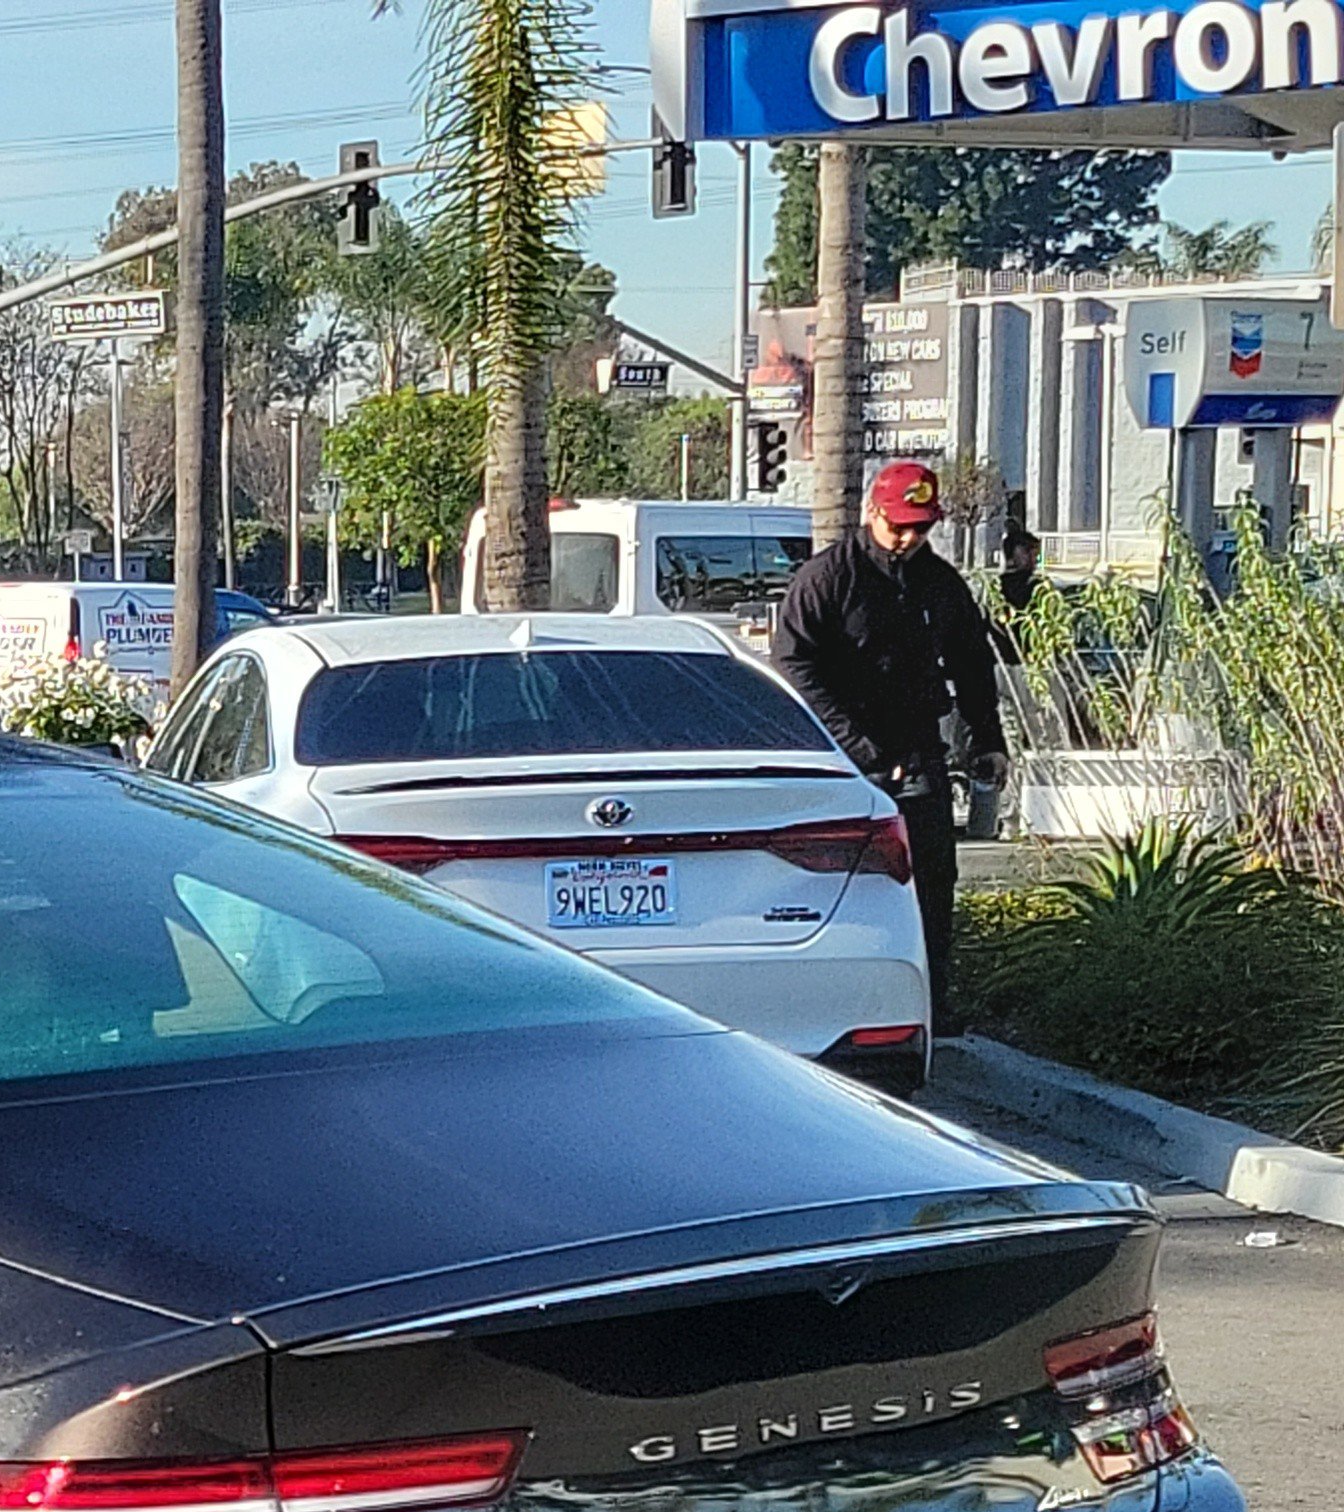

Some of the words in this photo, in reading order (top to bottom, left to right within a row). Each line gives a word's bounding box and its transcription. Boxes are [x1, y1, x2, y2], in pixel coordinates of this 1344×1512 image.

[808, 0, 1341, 123] Chevron
[52, 301, 159, 323] Studebaker
[1140, 330, 1187, 354] Self
[1300, 311, 1314, 350] 7
[912, 338, 941, 360] CARS
[870, 371, 913, 392] SPECIAL
[106, 626, 173, 644] PLUMBE
[556, 884, 666, 917] 9WEL920
[629, 1381, 983, 1462] GENESIS
